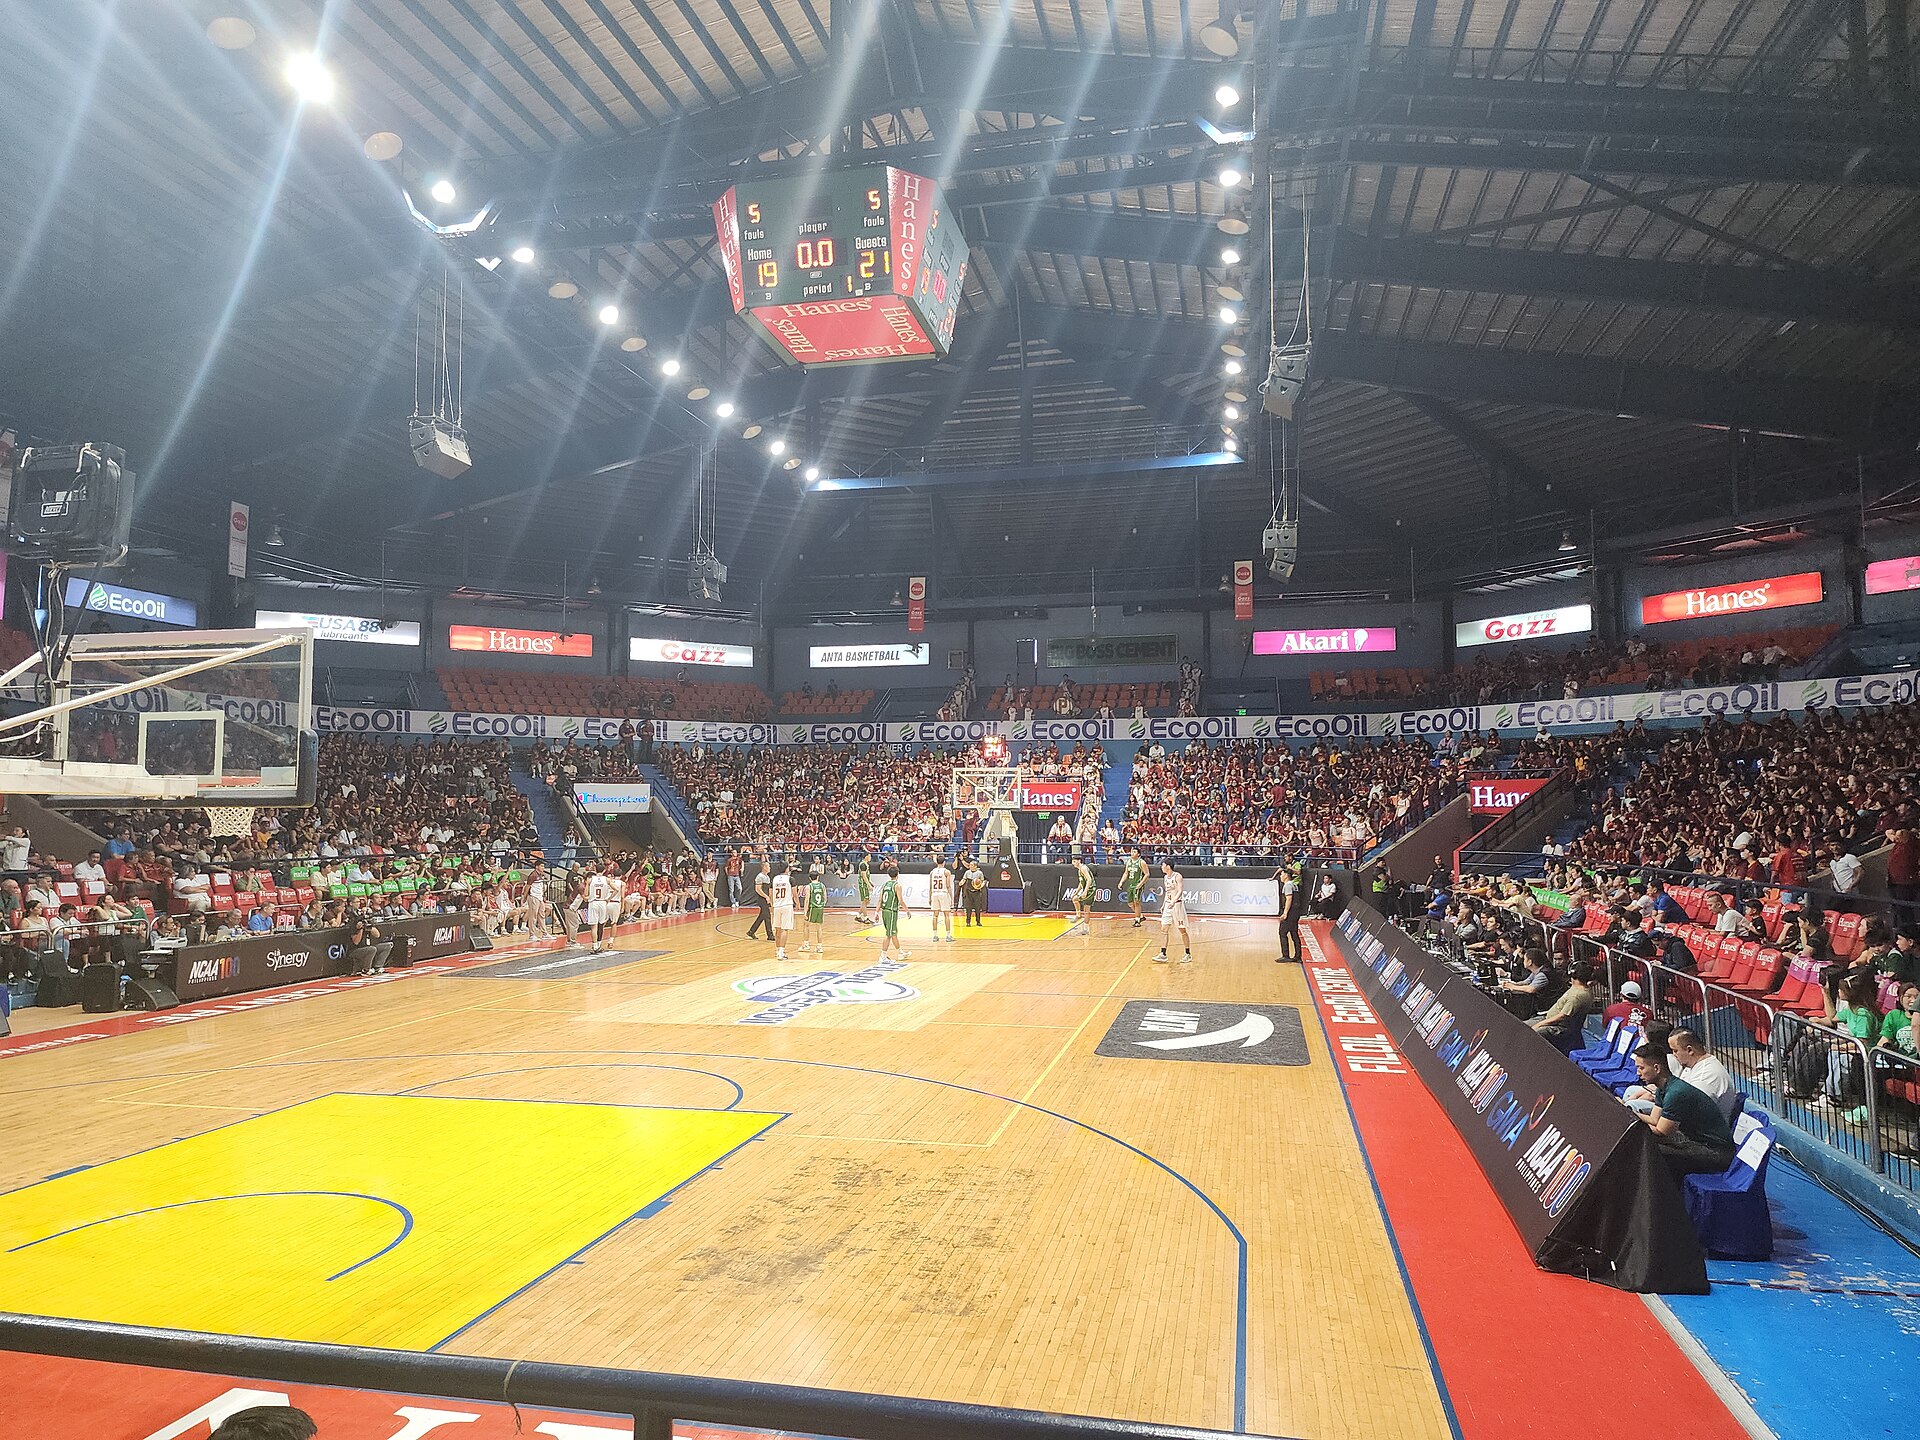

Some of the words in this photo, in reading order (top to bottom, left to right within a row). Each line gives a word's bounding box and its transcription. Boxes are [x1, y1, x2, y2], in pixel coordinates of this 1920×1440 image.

[867, 189, 881, 210] 5
[747, 203, 761, 224] 5
[863, 215, 885, 228] fouls
[743, 229, 765, 240] fouls
[798, 222, 828, 236] player
[900, 174, 922, 280] Hanes
[718, 193, 741, 296] Hanes
[855, 236, 887, 250] Guests
[747, 248, 772, 261] Home
[796, 238, 835, 270] 0.0
[859, 249, 890, 278] 21
[757, 261, 778, 288] 19
[846, 275, 853, 293] 1
[803, 282, 832, 298] period
[779, 297, 872, 318] Hanes
[880, 305, 920, 343] Hanes
[773, 318, 818, 354] Hanes
[825, 344, 909, 358] Hanes
[109, 593, 166, 619] EcoOil
[1685, 587, 1768, 615] Hanes
[320, 630, 369, 641] lubricants
[1485, 617, 1557, 640] Gazz
[488, 630, 554, 653] Hanes
[1116, 641, 1176, 658] CEMENT
[1280, 631, 1349, 652] Akari
[660, 643, 727, 664] Gazz
[820, 651, 844, 663] ANTA
[845, 650, 901, 662] BASKETBALL
[1660, 682, 1779, 716] EcoOil
[316, 706, 411, 732] EcoOil
[1400, 707, 1481, 733] EcoOil
[1518, 695, 1614, 727] EcoOil
[452, 712, 546, 736] EcoOil
[701, 722, 778, 744] EcoOil
[810, 723, 887, 743] EcoOil
[919, 721, 997, 741] EcoOil
[1032, 719, 1114, 740] EcoOil
[1150, 717, 1237, 739] EcoOil
[1275, 715, 1367, 737] EcoOil
[904, 743, 912, 752] G
[595, 888, 602, 899] 9
[775, 888, 787, 899] 20
[933, 880, 943, 890] 26
[815, 893, 822, 905] 9
[882, 889, 889, 903] 0
[1231, 893, 1272, 905] GMA
[1838, 917, 1856, 928] Hanes
[1720, 940, 1737, 952] Hanes
[266, 951, 310, 971] Synergy
[1757, 952, 1775, 963] Hanes
[1338, 1033, 1408, 1074] FILOIL
[1436, 1028, 1469, 1073] GMA
[1461, 1048, 1498, 1090] NCAA
[1469, 1062, 1509, 1115] 100
[1486, 1090, 1531, 1152] GMA
[1522, 1123, 1574, 1184] NCAA
[1514, 1157, 1544, 1194] PHILIPPINES
[1538, 1147, 1591, 1218] 100
